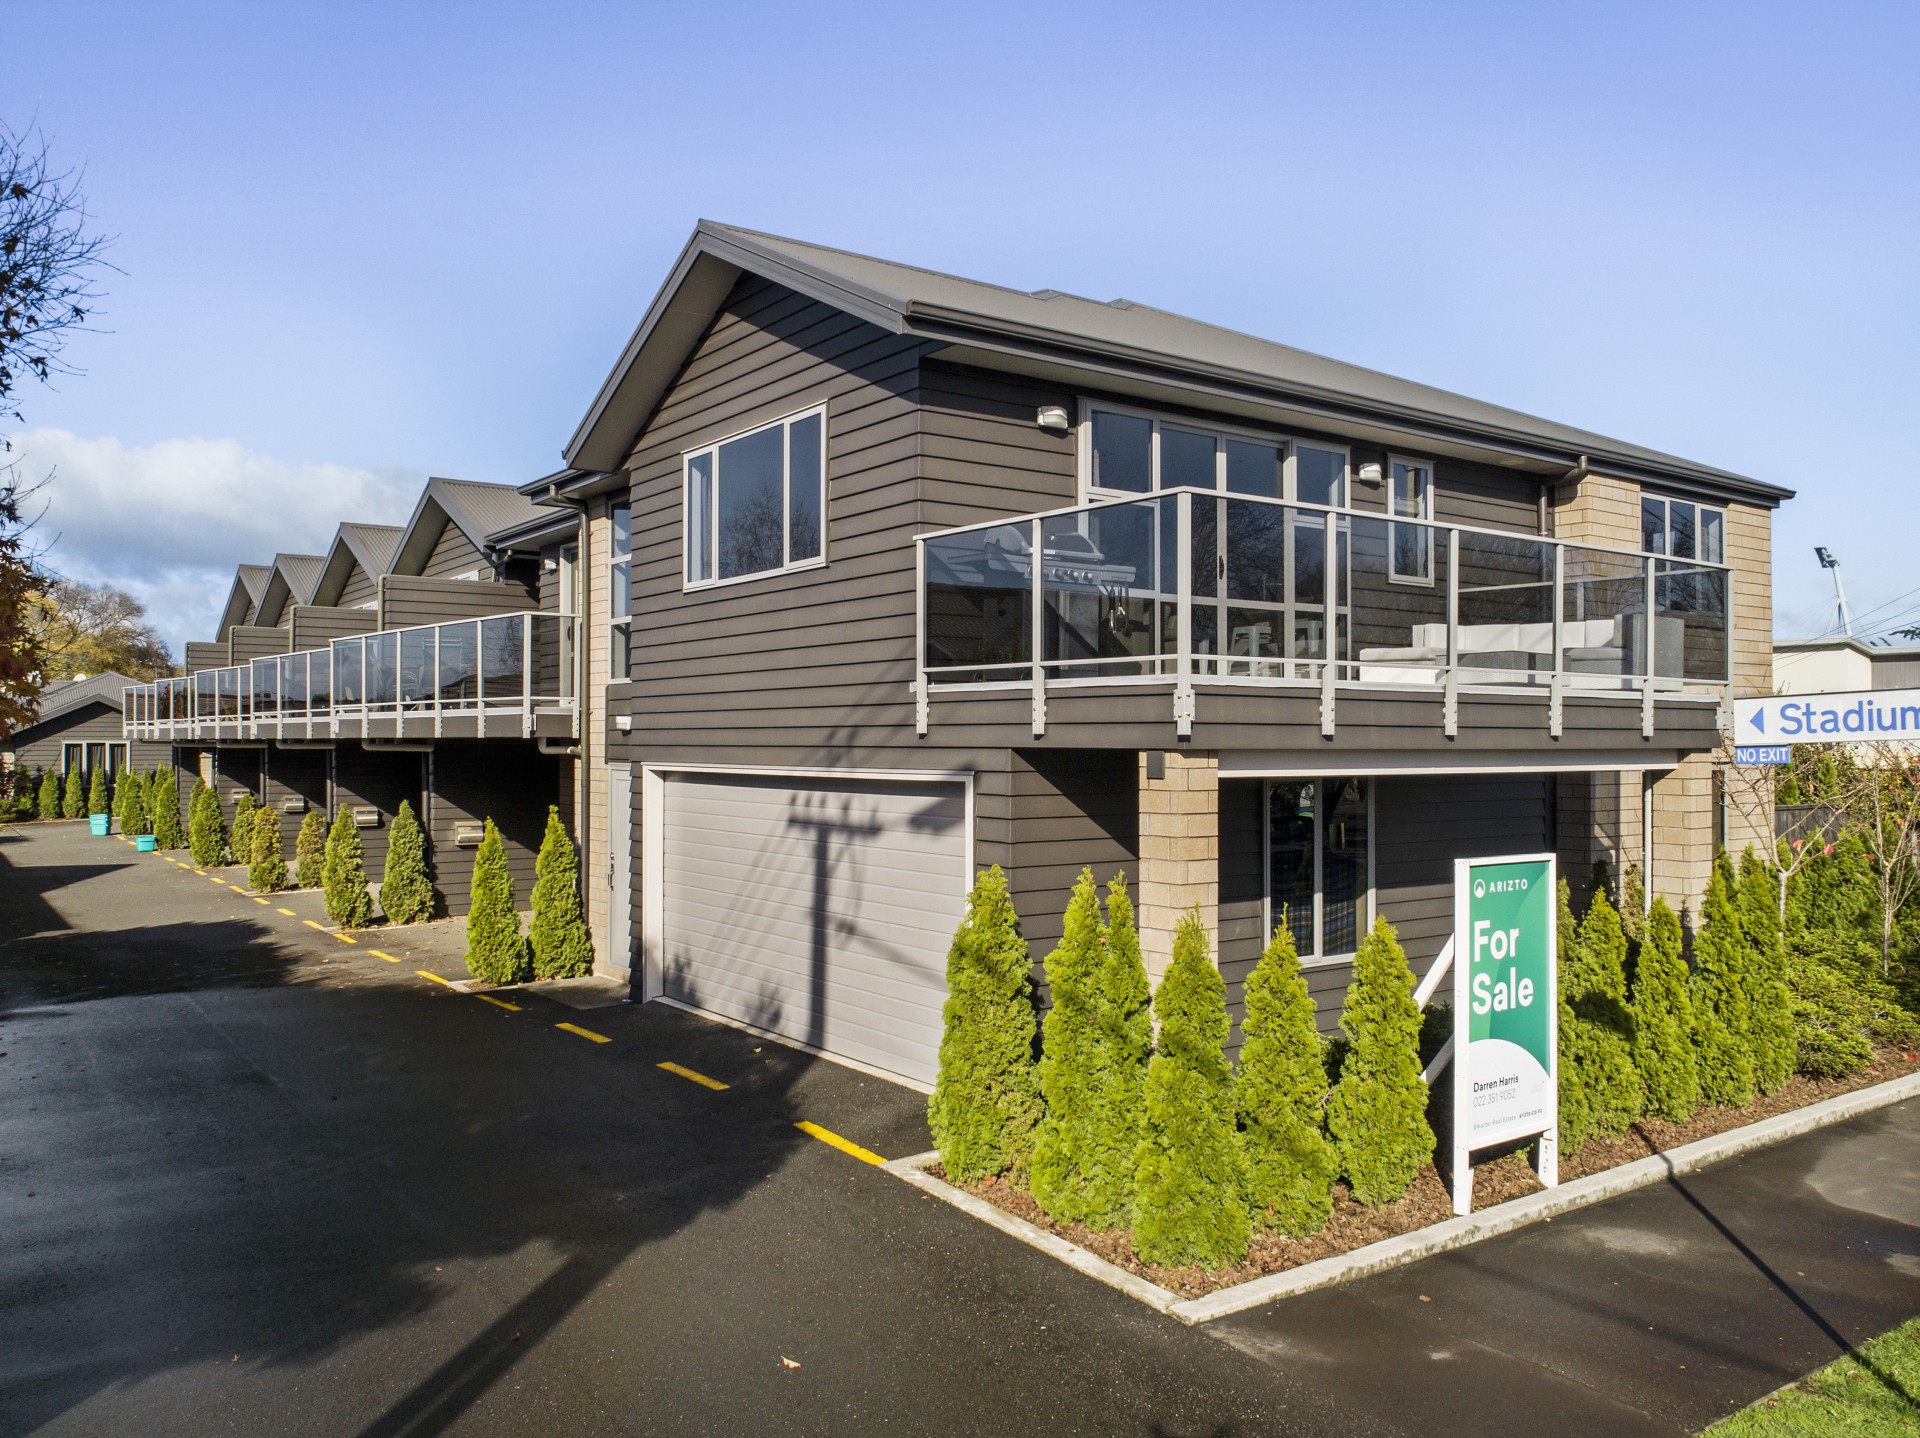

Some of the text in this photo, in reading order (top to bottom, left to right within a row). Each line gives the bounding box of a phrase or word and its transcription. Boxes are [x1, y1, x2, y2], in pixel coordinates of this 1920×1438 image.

[1737, 747, 1788, 762] NO EXIT
[1489, 879, 1528, 893] ARIZTO
[1474, 919, 1520, 962] For
[1472, 966, 1534, 1015] Sale
[1473, 1074, 1519, 1092] Darren Harris
[1473, 1095, 1486, 1107] 022
[1487, 1092, 1498, 1105] 351
